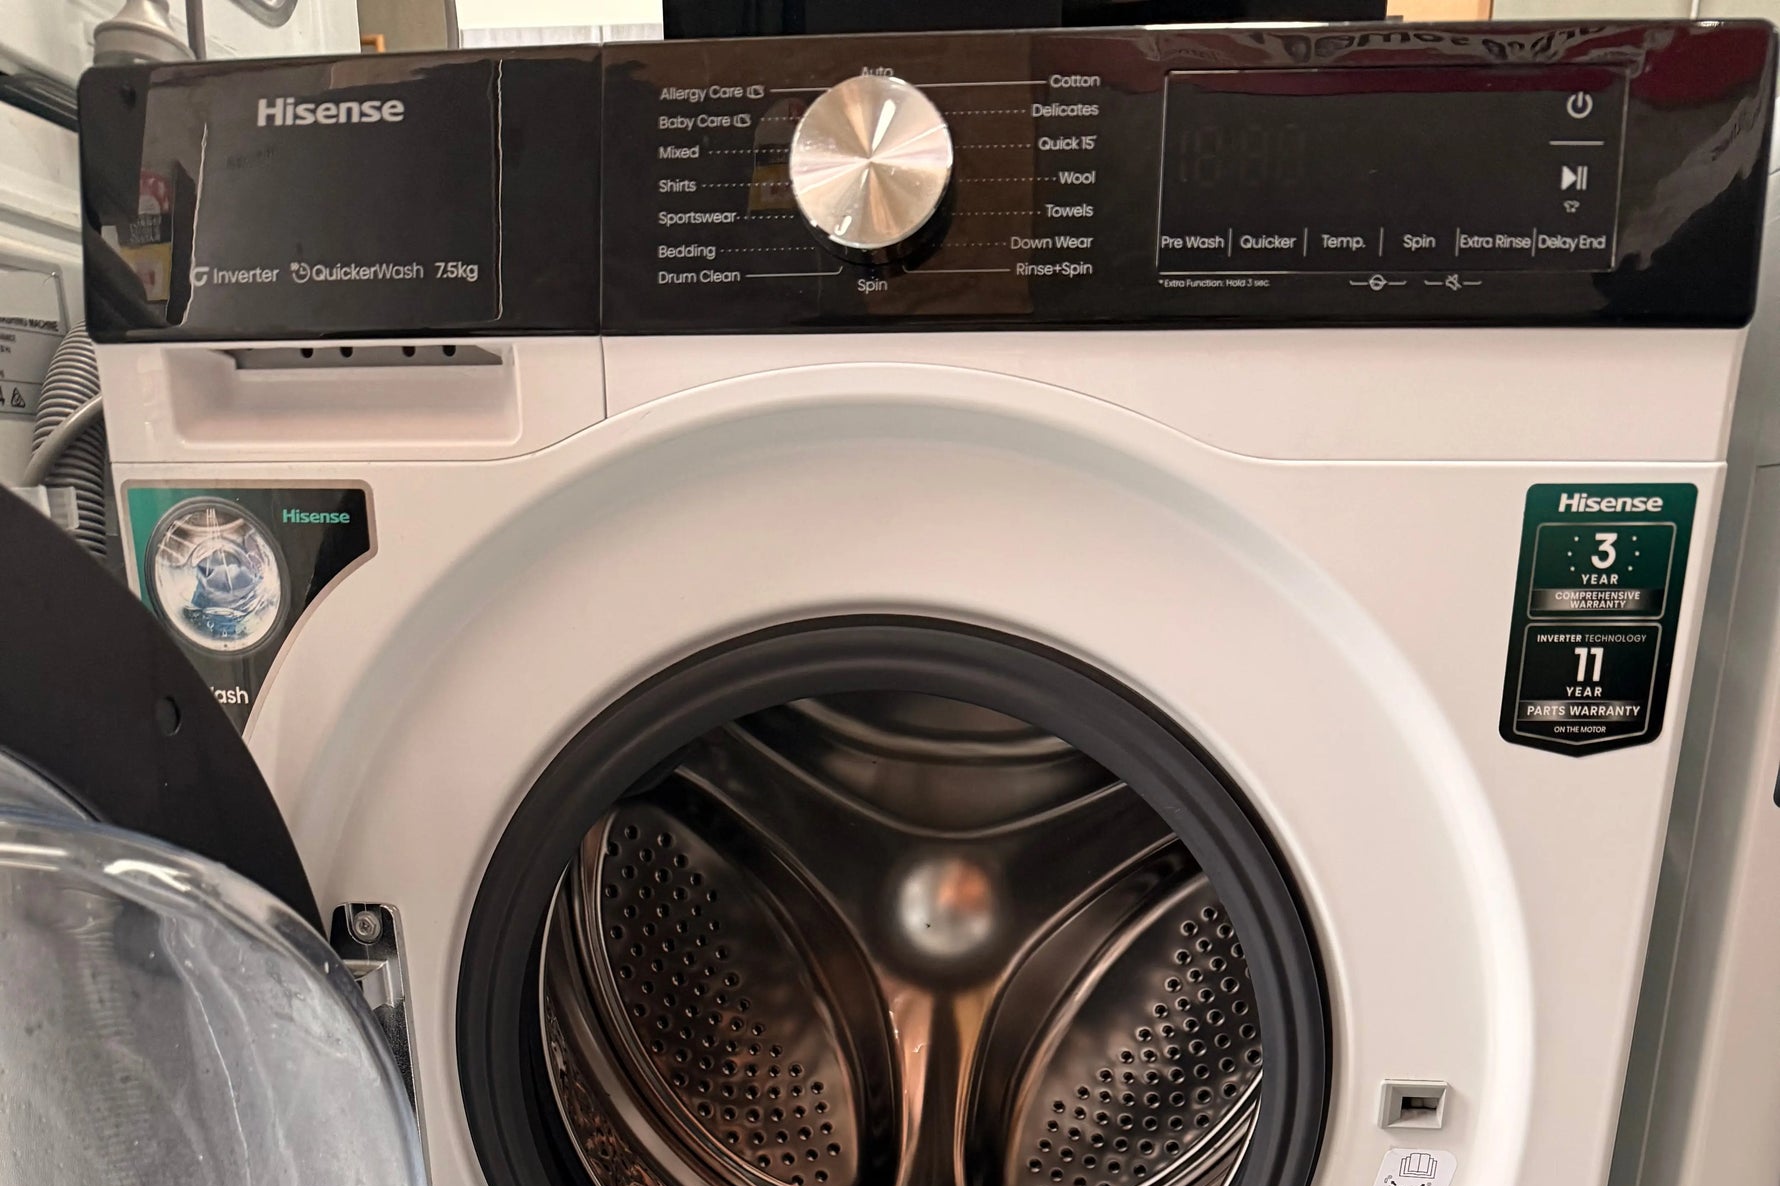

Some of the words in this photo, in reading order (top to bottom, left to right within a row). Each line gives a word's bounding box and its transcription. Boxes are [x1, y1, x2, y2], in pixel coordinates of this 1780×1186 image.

[1050, 74, 1100, 88] Cotton
[660, 86, 707, 102] Allergy
[709, 86, 743, 98] Care
[257, 98, 405, 127] Hisense
[1032, 103, 1099, 117] Delicates
[659, 115, 696, 130] Baby
[698, 114, 730, 127] Care
[1038, 137, 1080, 151] Quick
[659, 146, 699, 159] Mixed
[1059, 171, 1096, 185] Wool
[659, 179, 696, 193] Shirts
[659, 211, 736, 225] Sportswear
[1046, 204, 1093, 218] Towels
[1011, 236, 1052, 250] Down
[1055, 236, 1093, 249] Wear
[1161, 235, 1183, 249] Pre
[1185, 235, 1224, 249] Wash
[1240, 235, 1296, 250] Quicker
[1322, 235, 1366, 252] Temp.
[1403, 235, 1436, 251] Spin
[1460, 235, 1492, 249] Extra
[1495, 235, 1531, 249] Rinse
[1538, 235, 1577, 251] Delay
[1579, 235, 1606, 249] End
[659, 244, 716, 260] Bedding
[213, 267, 278, 284] Inverter
[312, 262, 424, 282] QuickerWash
[435, 262, 479, 282] 7.5kg
[1016, 261, 1093, 278] Rinse+Spin
[659, 271, 697, 284] Drum
[700, 270, 740, 283] Clean
[1226, 279, 1246, 287] Hold
[1247, 279, 1253, 287] 3
[857, 278, 888, 294] Spin
[1558, 493, 1663, 513] Hisense
[282, 508, 351, 525] Hisense
[1591, 532, 1618, 569] 3
[1581, 574, 1619, 585] YEAR
[1555, 591, 1641, 600] COMPREHENSIVE
[1570, 600, 1626, 609] WARRANTY
[1537, 634, 1582, 643] INVERTER
[1584, 634, 1647, 643] TECHNOLOGY
[1574, 647, 1604, 682] 11
[210, 686, 249, 704] ash
[1566, 686, 1602, 697] YEAR
[1527, 705, 1566, 716] PARTS
[1569, 705, 1640, 717] WARRANTY
